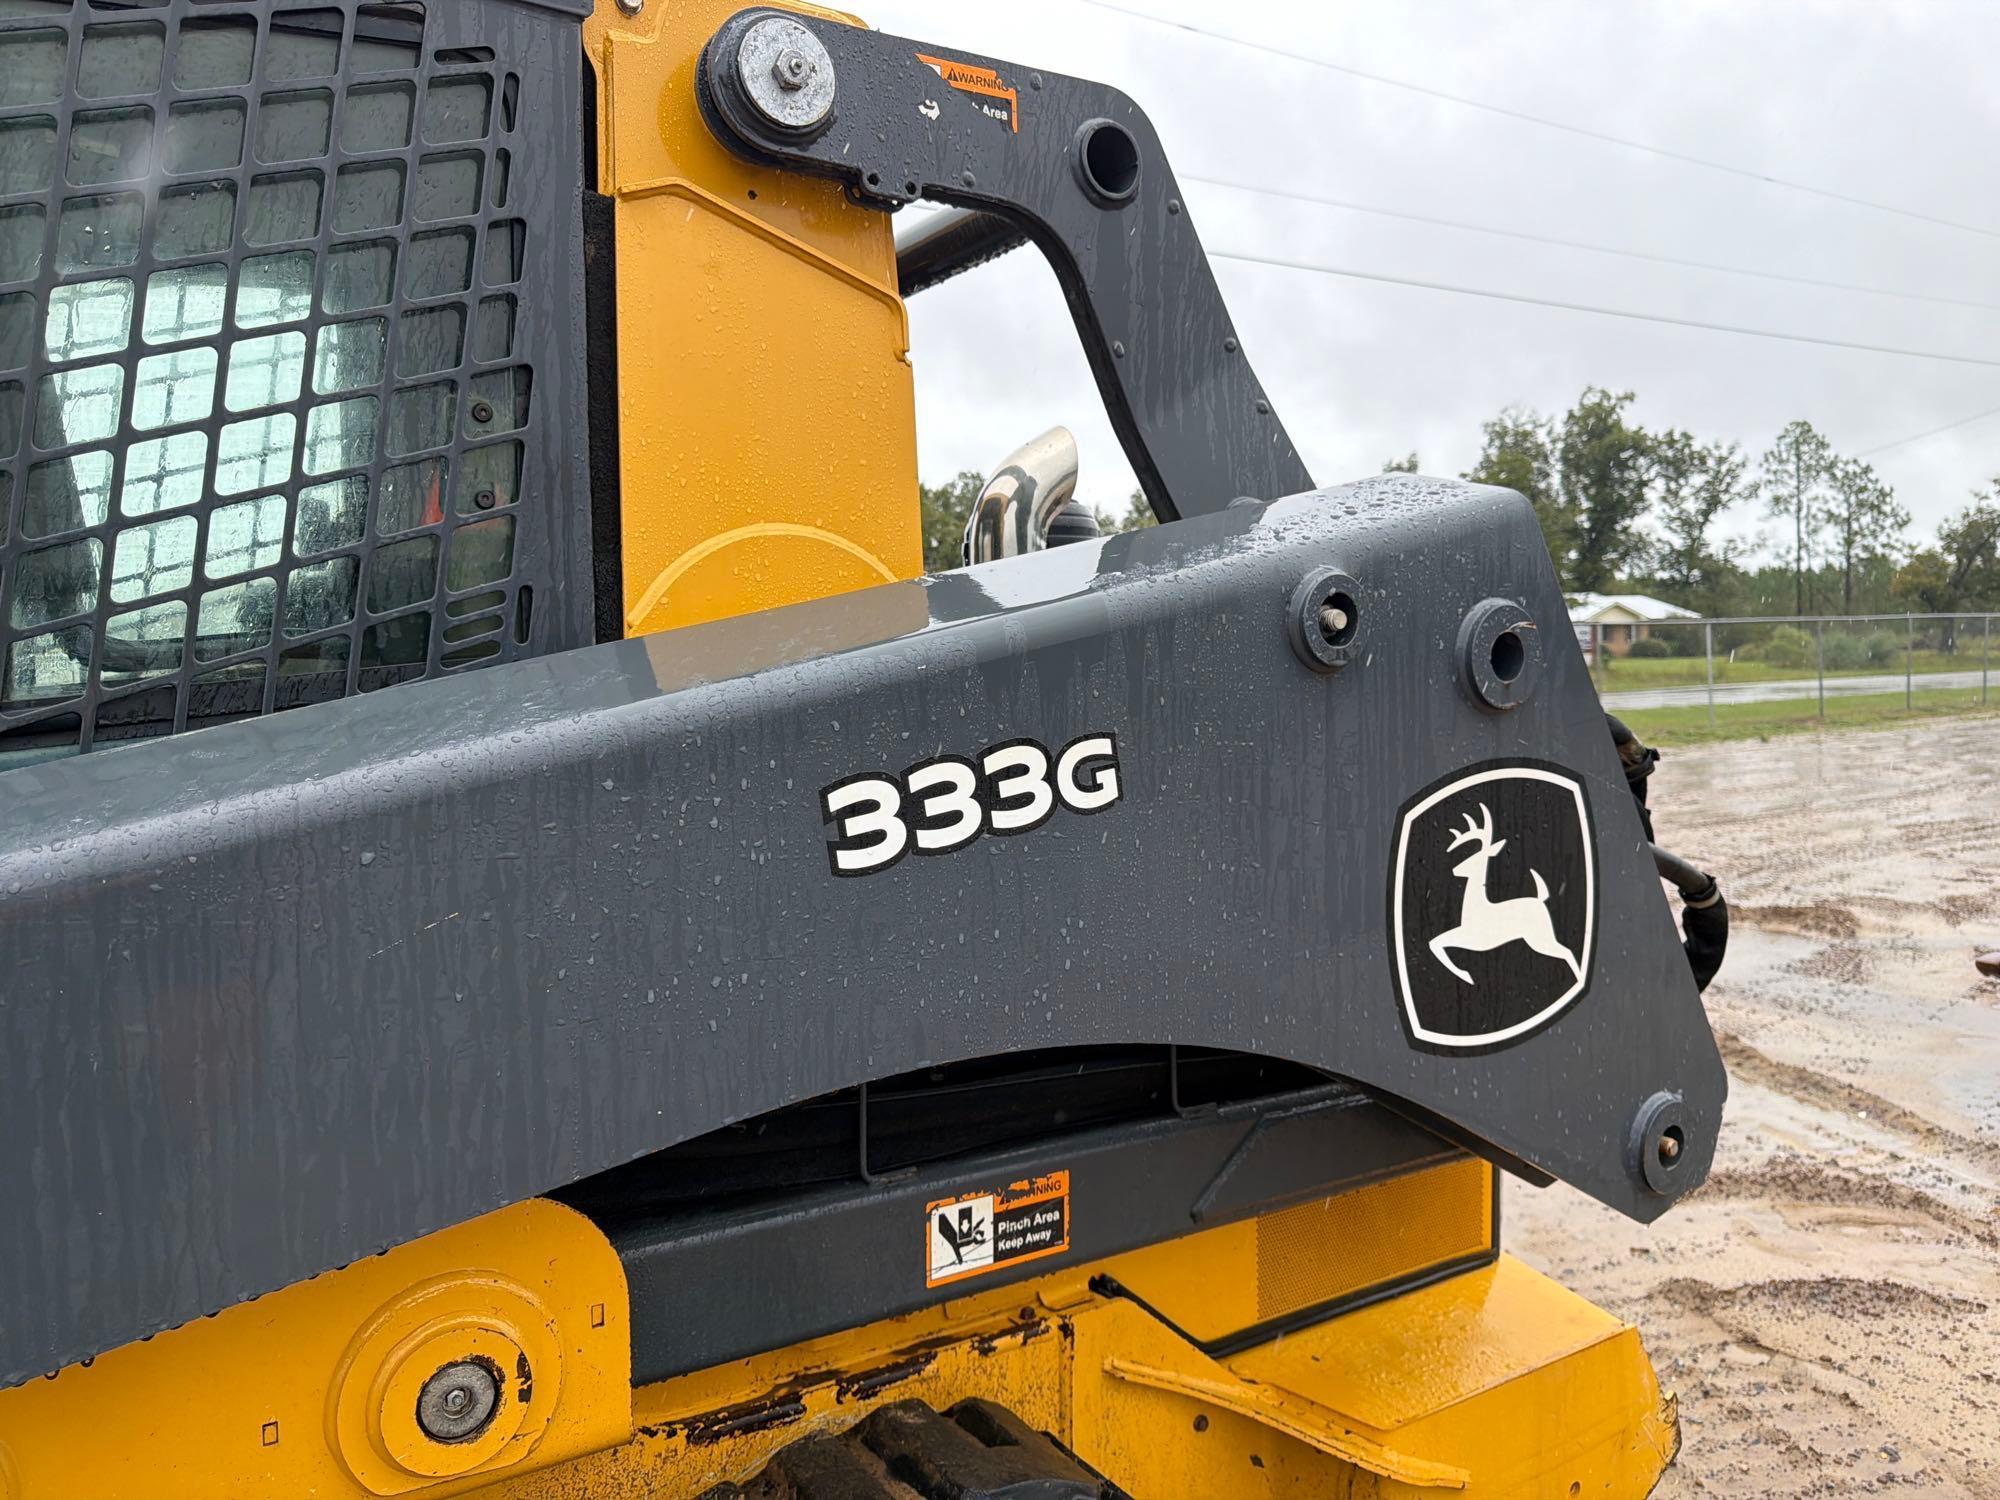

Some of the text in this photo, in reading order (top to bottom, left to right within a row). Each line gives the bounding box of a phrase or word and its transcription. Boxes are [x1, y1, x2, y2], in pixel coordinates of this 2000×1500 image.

[983, 104, 1008, 120] Area
[826, 737, 1120, 870] 333G
[998, 1210, 1060, 1234] Pinch Area
[998, 1229, 1052, 1251] Keep Away
